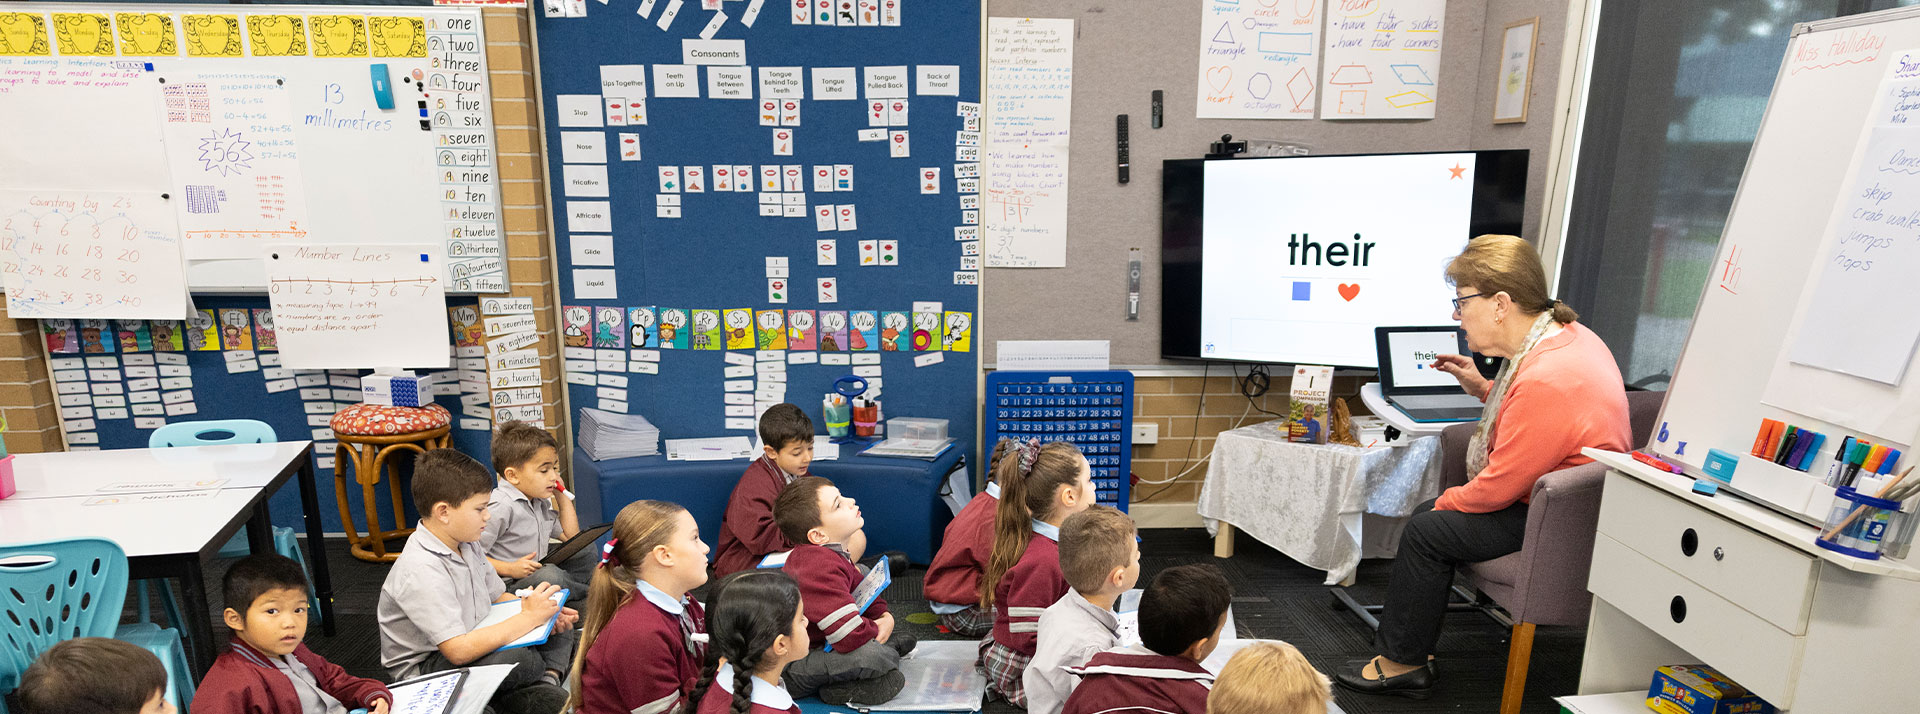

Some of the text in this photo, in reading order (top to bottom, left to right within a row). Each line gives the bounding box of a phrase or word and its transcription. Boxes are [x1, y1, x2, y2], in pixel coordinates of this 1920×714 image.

[1212, 5, 1240, 16] square
[1254, 8, 1280, 18] circle
[447, 18, 472, 30] one
[1292, 16, 1314, 25] oval
[1341, 17, 1365, 30] have
[1412, 18, 1439, 30] sides
[74, 28, 95, 38] Monday
[266, 30, 290, 40] Thursday
[330, 30, 348, 40] Friday
[386, 31, 411, 42] Saturday
[448, 34, 474, 50] two
[1338, 33, 1362, 48] have
[1404, 38, 1439, 48] corners
[1794, 28, 1887, 63] Miss Halliday
[690, 49, 740, 58] Consonants
[1208, 45, 1246, 60] triangle
[24, 59, 58, 68] Learning
[444, 52, 479, 71] three
[1264, 54, 1298, 66] rectangle
[5, 70, 41, 79] learning
[769, 71, 792, 79] Tongue
[874, 74, 897, 82] Tongue
[452, 73, 481, 90] four
[603, 80, 644, 88] Lips Together
[676, 81, 685, 89] Lip
[786, 79, 799, 87] Top
[324, 83, 344, 105] 13
[1206, 94, 1234, 104] heart
[456, 94, 480, 110] five
[1244, 101, 1281, 112] octagon
[574, 109, 588, 118] Stop
[960, 105, 978, 114] says
[304, 108, 392, 133] millimetres
[464, 114, 482, 126] six
[968, 118, 976, 126] of
[449, 133, 485, 144] seven
[960, 132, 978, 141] from
[213, 140, 240, 163] 56
[461, 148, 487, 167] eight
[960, 148, 977, 156] said
[957, 164, 976, 172] what
[462, 169, 489, 182] nine
[465, 185, 486, 202] ten
[1862, 182, 1893, 206] skip
[30, 195, 76, 212] Counting
[83, 194, 99, 214] by
[462, 206, 495, 220] eleven
[1852, 207, 1884, 222] crab
[92, 224, 101, 240] 8
[123, 225, 138, 240] 10
[464, 225, 496, 237] twelve
[958, 228, 976, 237] your
[998, 236, 1014, 246] 37
[1840, 230, 1894, 253] jumps
[2, 238, 140, 263] 12 14 16 18 20
[294, 246, 391, 262] Number Lines
[453, 243, 499, 255] 13 thirteen
[1288, 232, 1376, 266] their
[1723, 244, 1743, 289] th
[1834, 249, 1873, 272] hops
[468, 260, 500, 274] fourteen
[118, 270, 138, 284] 30
[956, 274, 976, 282] goes
[475, 280, 503, 290] fifteen
[586, 280, 604, 288] Liquid
[503, 301, 532, 310] sixteen
[228, 312, 241, 324] Ff
[457, 309, 475, 321] Mm
[572, 310, 585, 322] Nn
[604, 310, 617, 323] Oo
[637, 310, 650, 324] Pp
[701, 312, 713, 324] Rr
[733, 312, 744, 324] Ss
[765, 314, 776, 326] Tt
[795, 314, 809, 326] Uu
[854, 314, 876, 328] Ww
[919, 312, 934, 330] Yy
[953, 314, 964, 328] Zz
[502, 318, 536, 331] seventeen
[828, 316, 840, 328] Vv
[508, 333, 538, 350] eighteen
[508, 356, 539, 366] nineteen
[1414, 350, 1438, 360] their
[512, 372, 540, 384] twenty
[516, 390, 541, 403] thirty
[520, 408, 542, 420] forty
[1656, 422, 1669, 443] b
[1674, 440, 1687, 455] x
[142, 493, 208, 501] Nicholas
